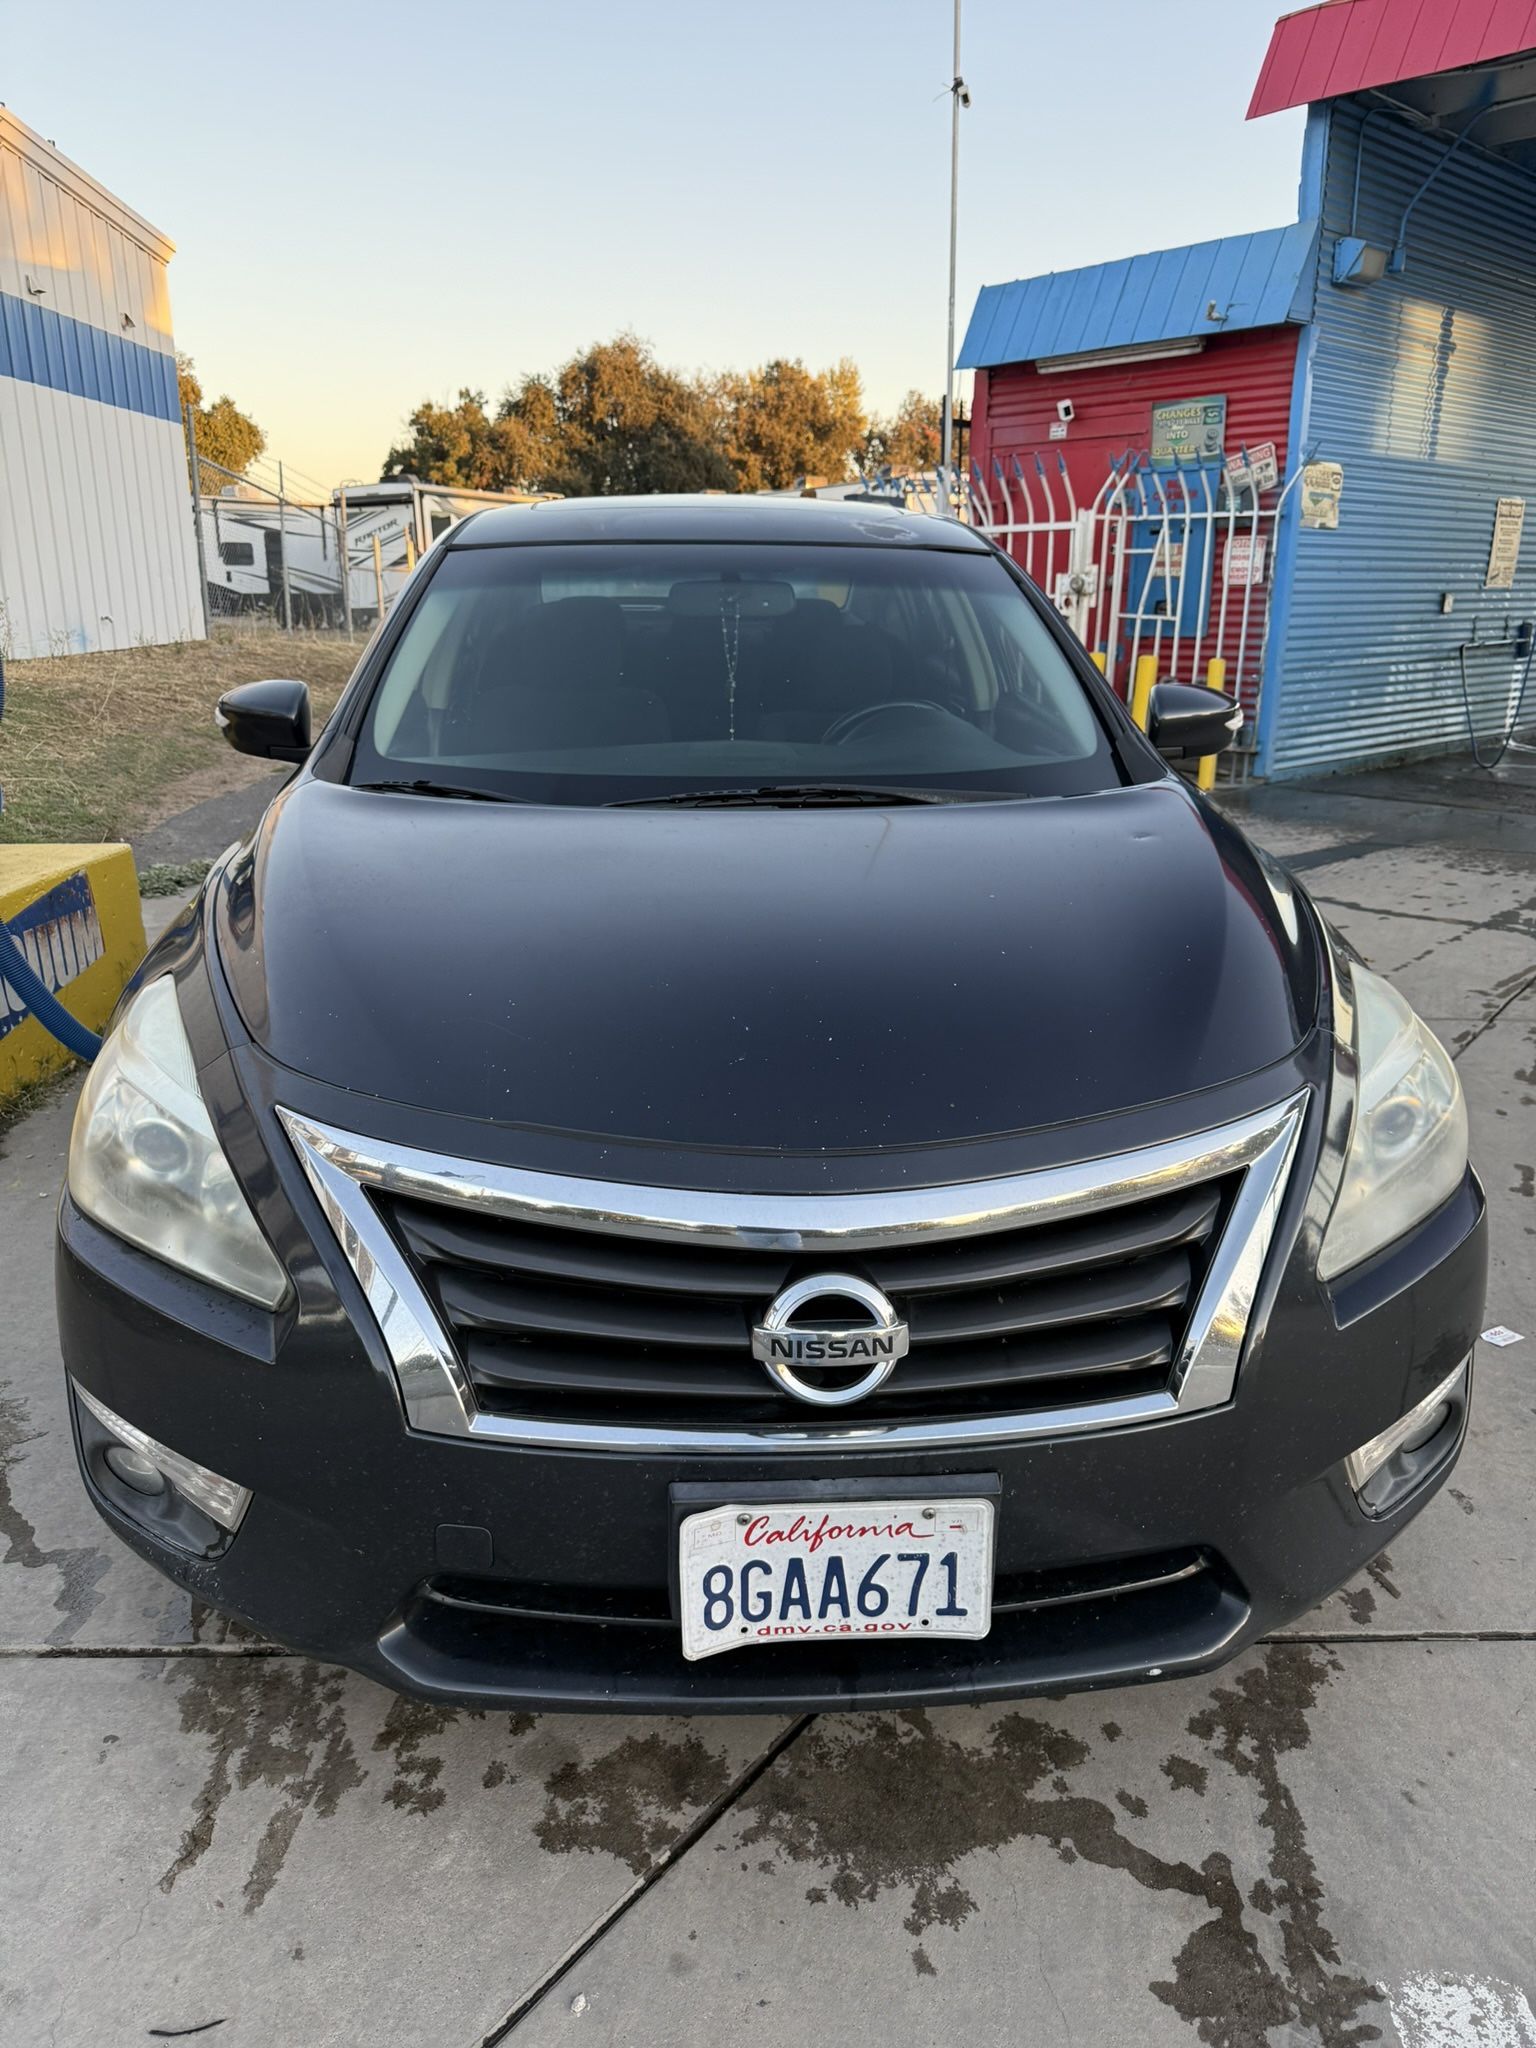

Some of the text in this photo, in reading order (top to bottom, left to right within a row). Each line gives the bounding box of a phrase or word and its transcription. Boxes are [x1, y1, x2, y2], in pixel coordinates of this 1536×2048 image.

[1155, 407, 1201, 421] CHANGES
[1166, 430, 1188, 440] INTO
[1227, 447, 1272, 472] WANING
[770, 1336, 893, 1359] NISSAN
[744, 1514, 934, 1552] California
[702, 1551, 968, 1631] 8GAA671
[757, 1622, 912, 1636] dmv.ca.gov
